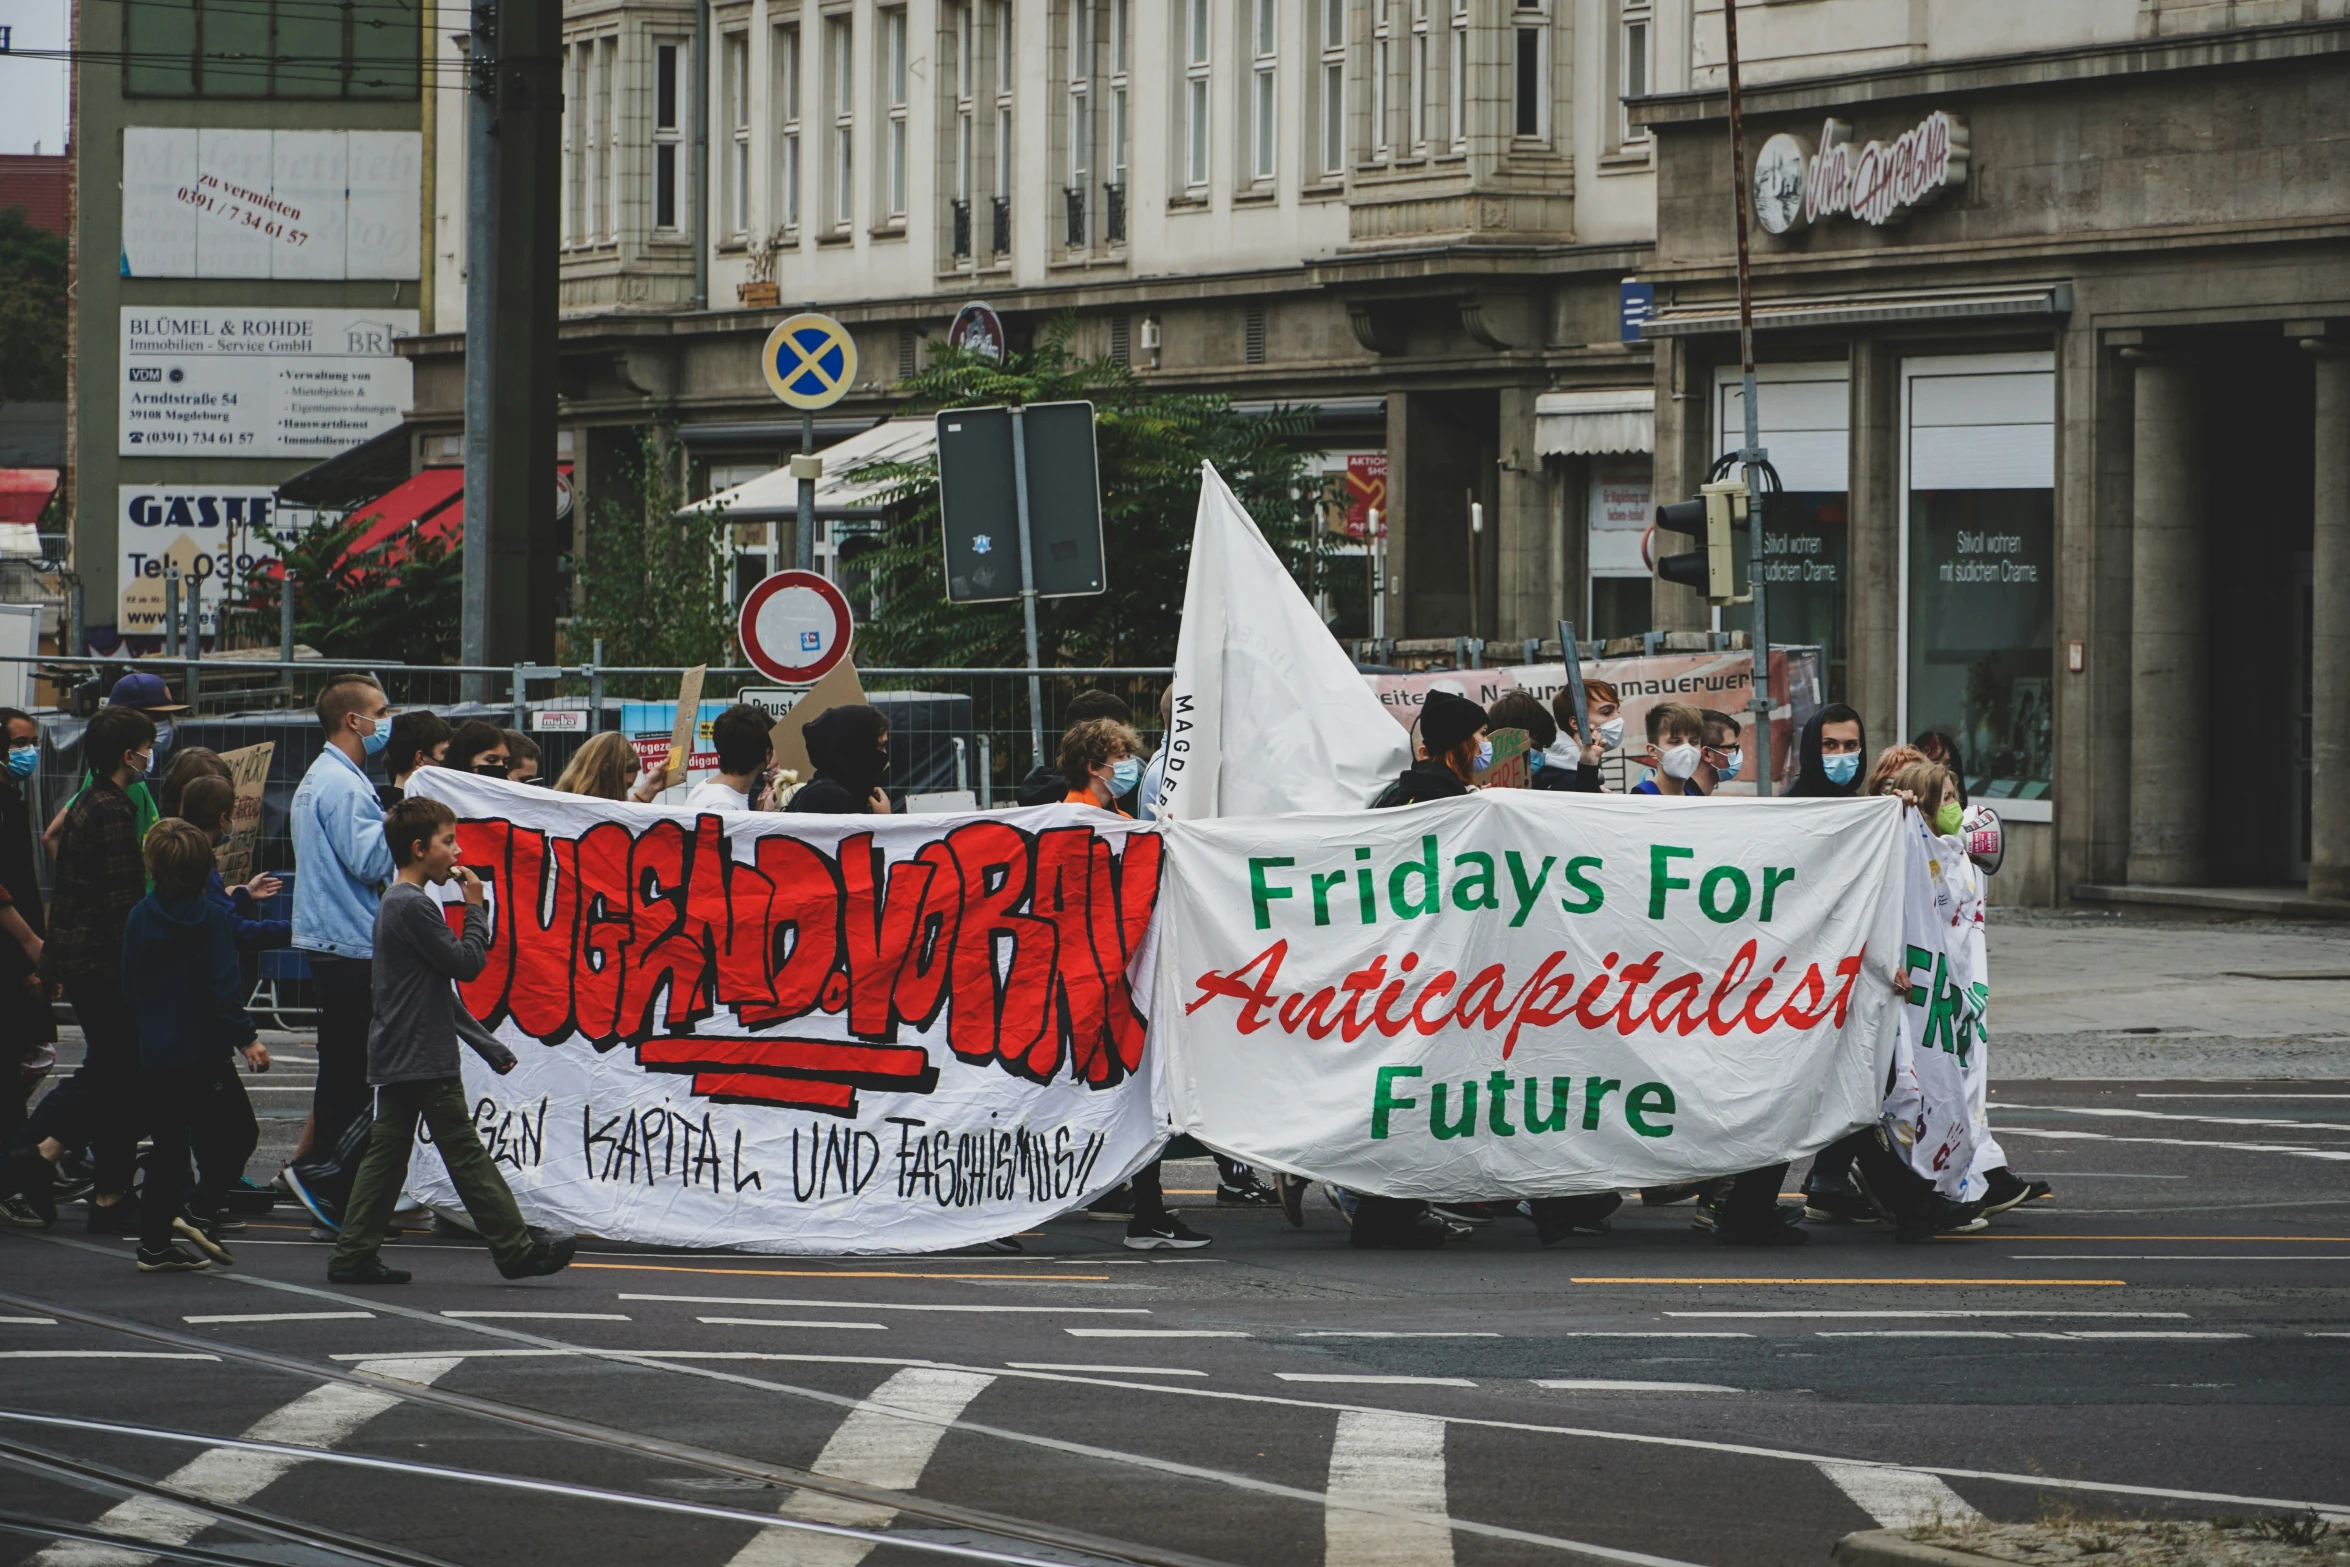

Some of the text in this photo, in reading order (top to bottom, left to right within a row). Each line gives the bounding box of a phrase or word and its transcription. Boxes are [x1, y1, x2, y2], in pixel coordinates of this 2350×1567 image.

[1853, 117, 1948, 220] CAMPAGNA
[199, 173, 219, 189] zu
[223, 181, 302, 221] vermieten
[177, 187, 214, 212] 0391
[229, 206, 239, 220] 7
[240, 210, 261, 230] 34
[264, 221, 284, 239] 61
[286, 230, 309, 247] 57
[129, 316, 314, 338] BLÜMEL & ROHDE
[129, 339, 204, 352] Immobilien
[217, 339, 265, 353] Service
[268, 340, 313, 353] GmbH
[130, 369, 161, 382] VDM
[286, 370, 371, 383] Verwaltung von
[131, 391, 238, 407] Arndtstraße 54
[128, 409, 230, 423] 39108 Magdeburg
[146, 430, 255, 446] (0391) 734 61 57
[1790, 533, 1822, 555] wohnen
[1957, 530, 2022, 554] Stilvoll wohnen
[1764, 560, 1801, 582] üdlichem
[1248, 833, 1796, 931] Fridays For
[1185, 938, 1868, 1062] Anticapitalist
[1370, 1064, 1677, 1141] Future
[584, 1096, 762, 1194] KAPITAL
[792, 1120, 881, 1202] UND
